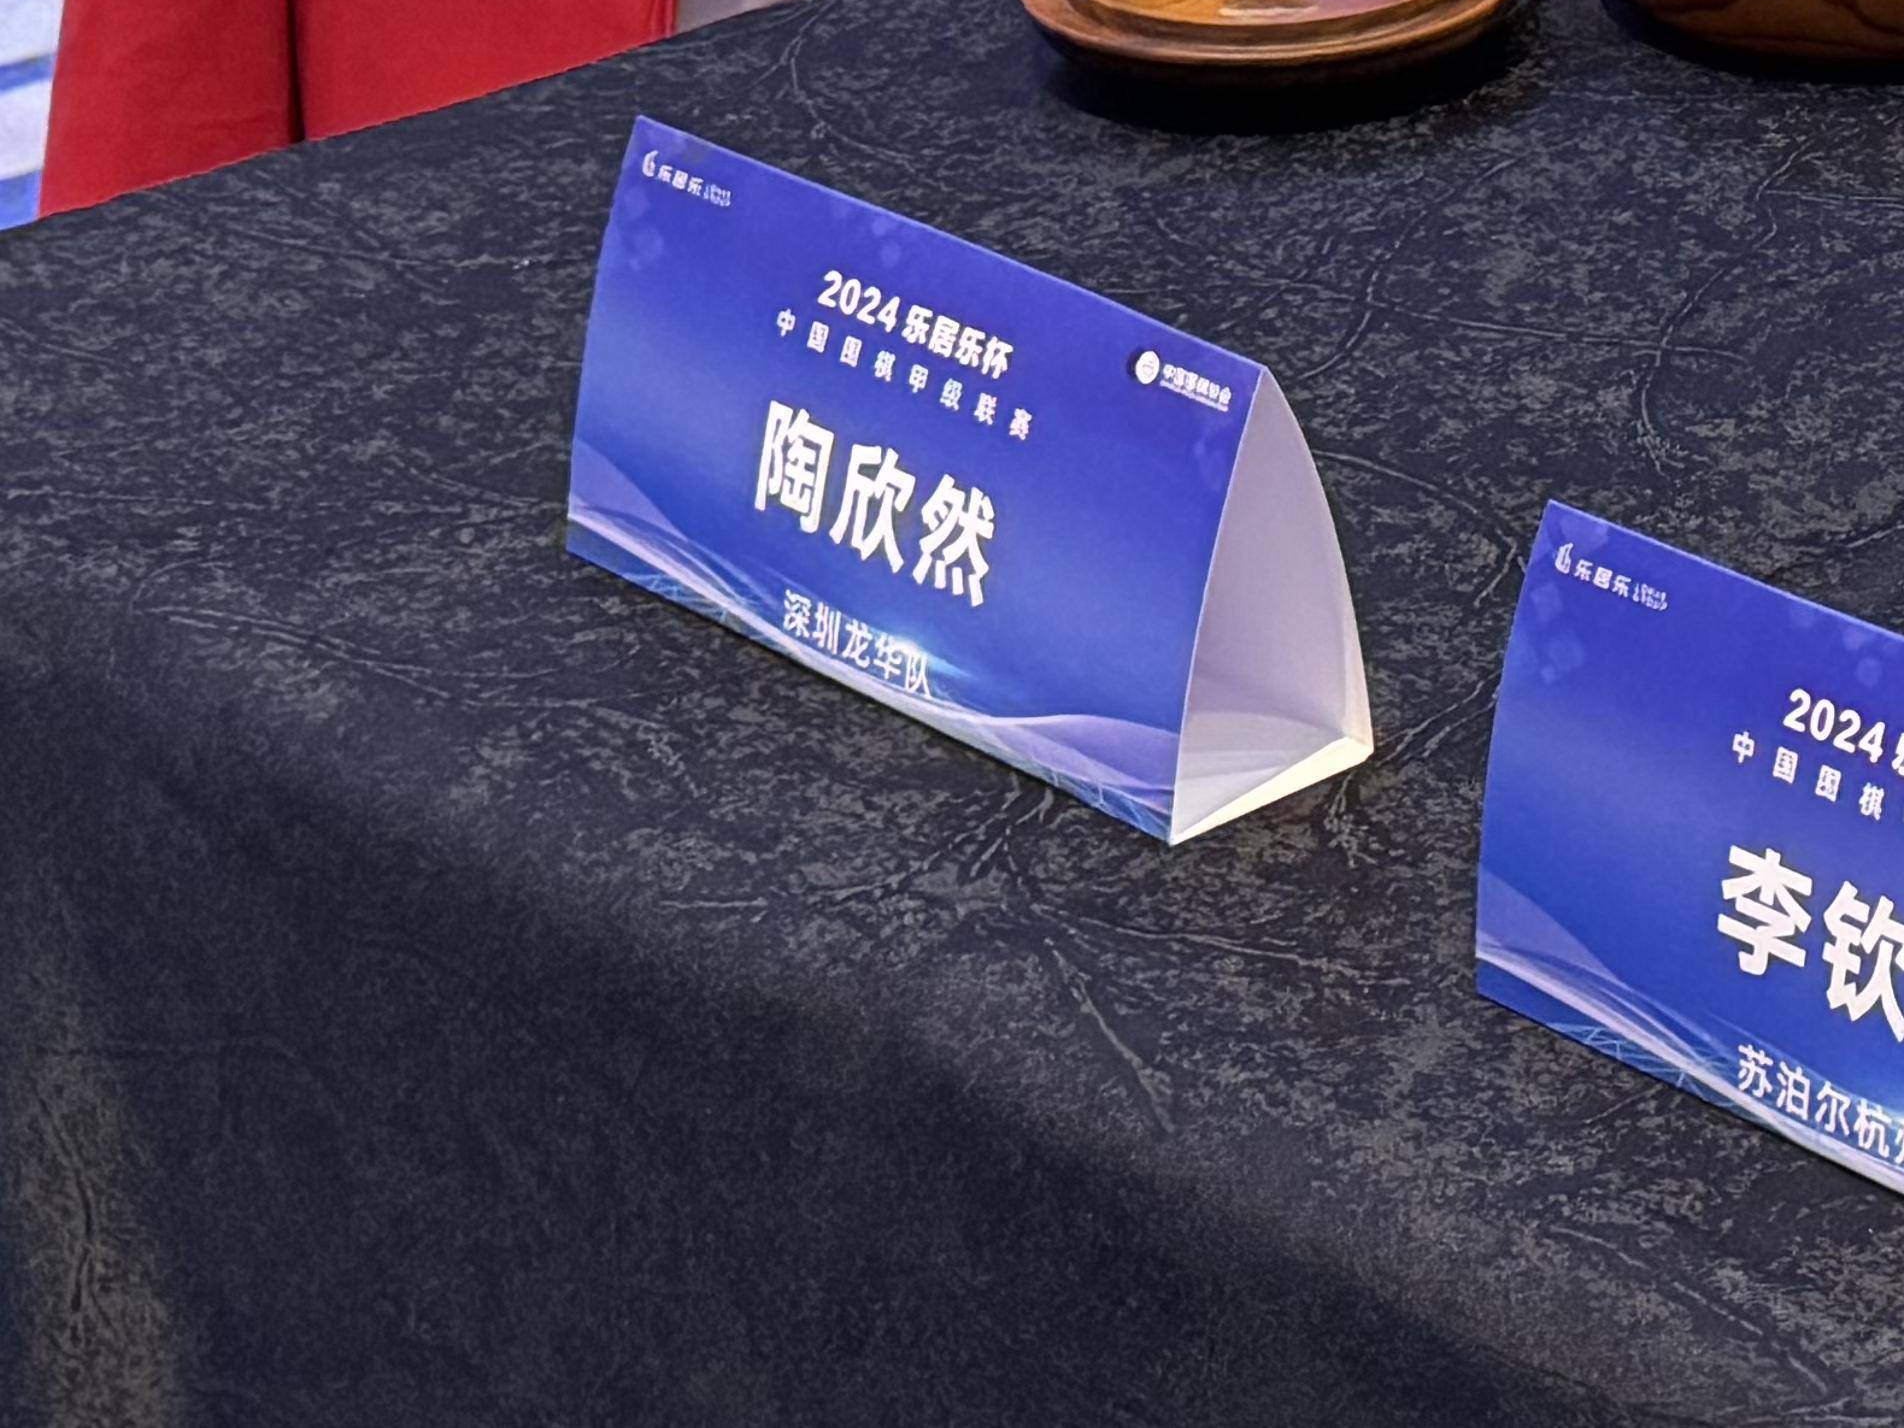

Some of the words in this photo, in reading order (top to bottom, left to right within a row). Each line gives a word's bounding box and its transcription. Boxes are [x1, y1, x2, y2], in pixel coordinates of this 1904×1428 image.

[777, 308, 1032, 440] 中国围棋甲级联赛
[818, 270, 899, 331] 2024
[902, 306, 1014, 379] 乐居乐杯
[755, 400, 995, 606] 陶欣然
[782, 590, 932, 699] 深圳龙华队
[1783, 689, 1885, 763] 2024
